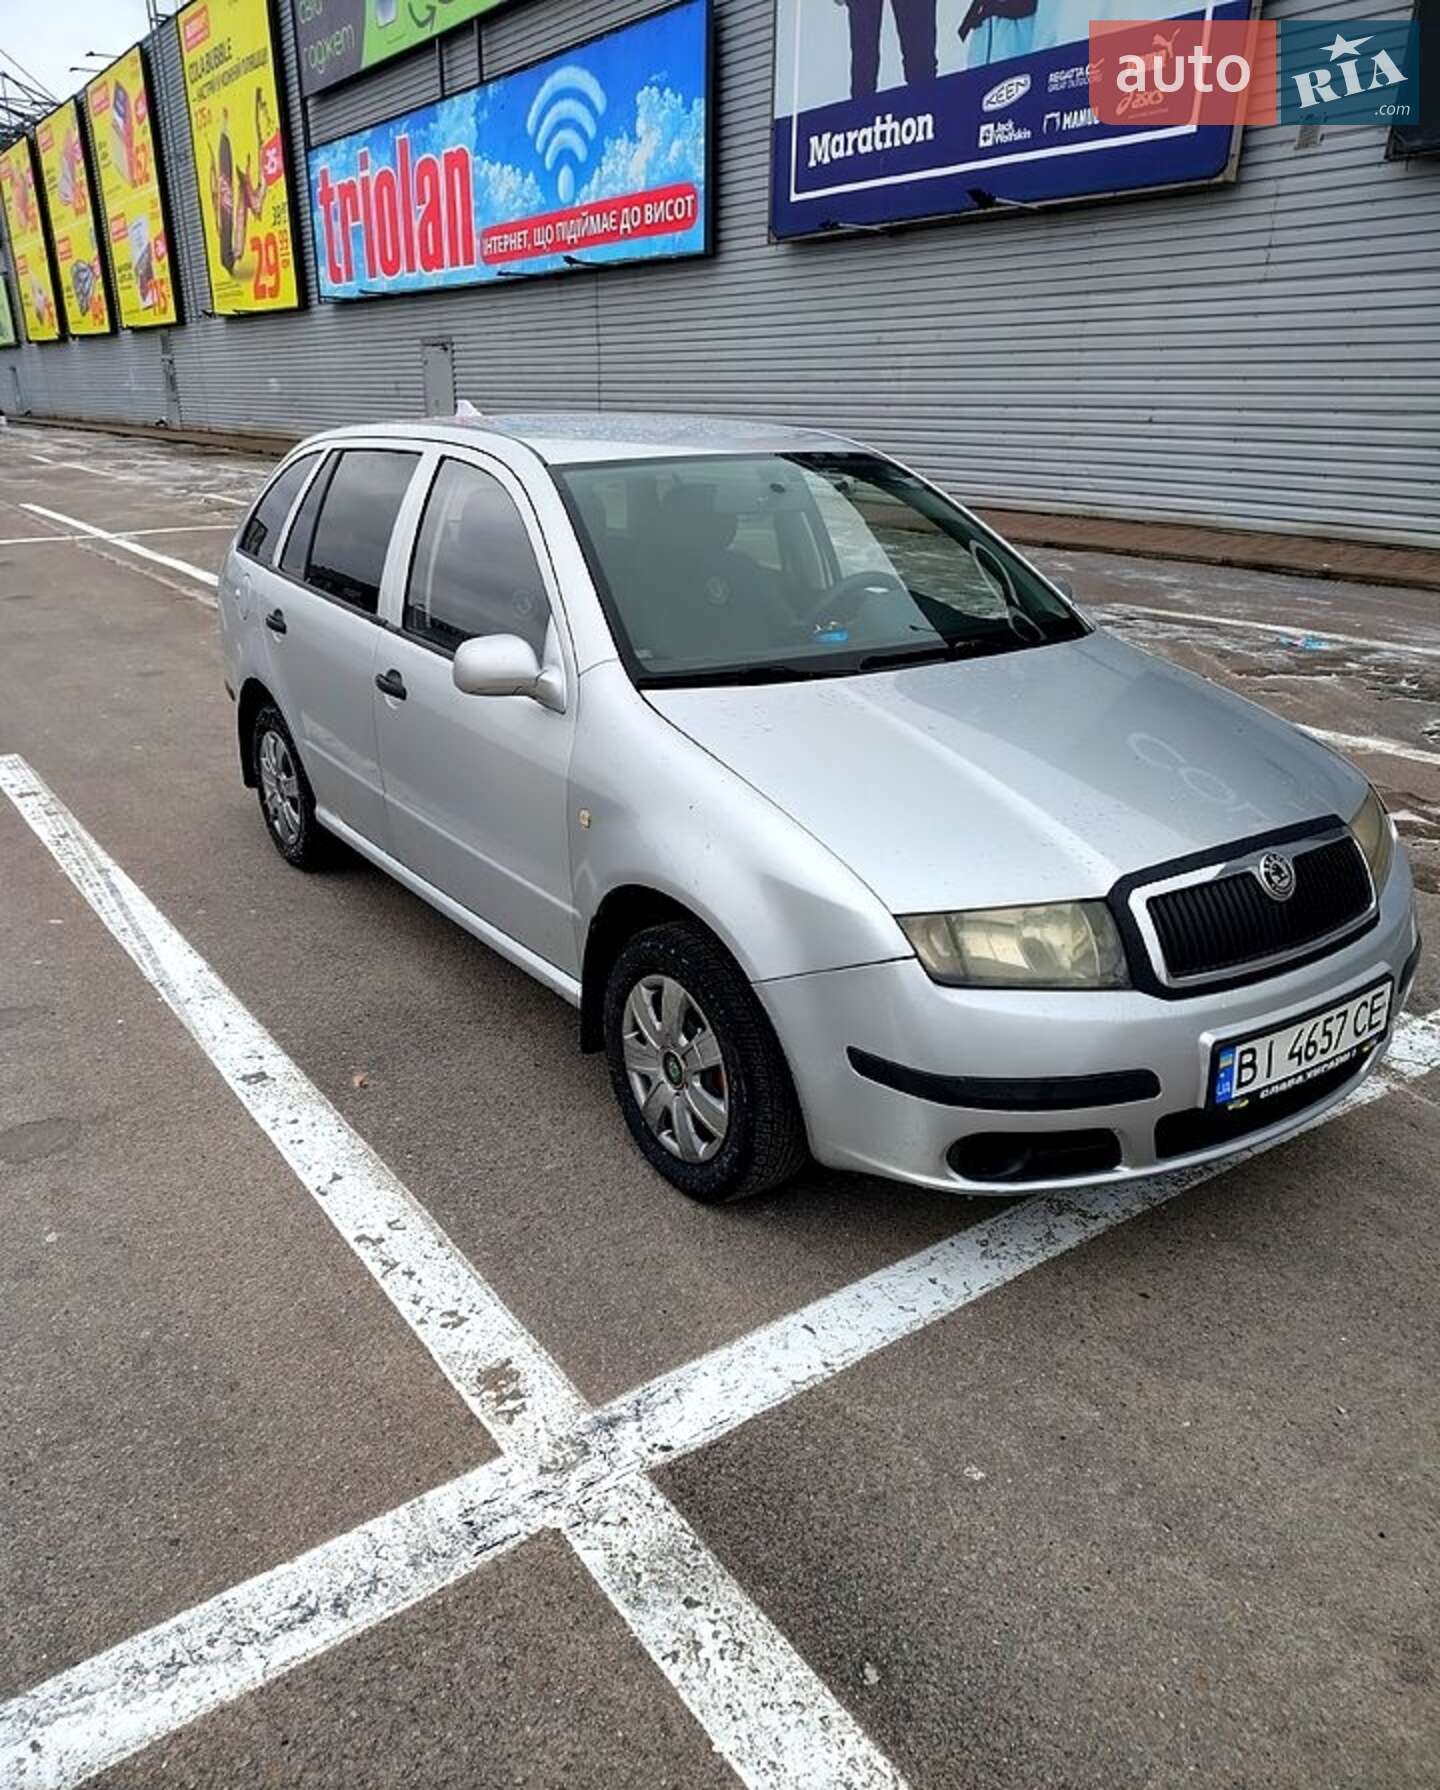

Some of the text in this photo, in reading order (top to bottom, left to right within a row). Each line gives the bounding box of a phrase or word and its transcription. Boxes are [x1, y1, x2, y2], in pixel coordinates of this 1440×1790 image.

[984, 79, 1027, 107] KEEN
[808, 112, 935, 168] Marathon
[317, 134, 476, 286] triolan
[533, 223, 554, 249] ЩО
[620, 206, 641, 235] ДО
[644, 194, 695, 226] ВИСОТ
[1236, 1040, 1275, 1090] BI
[1287, 1009, 1349, 1067] 4657
[1353, 991, 1385, 1038] CE
